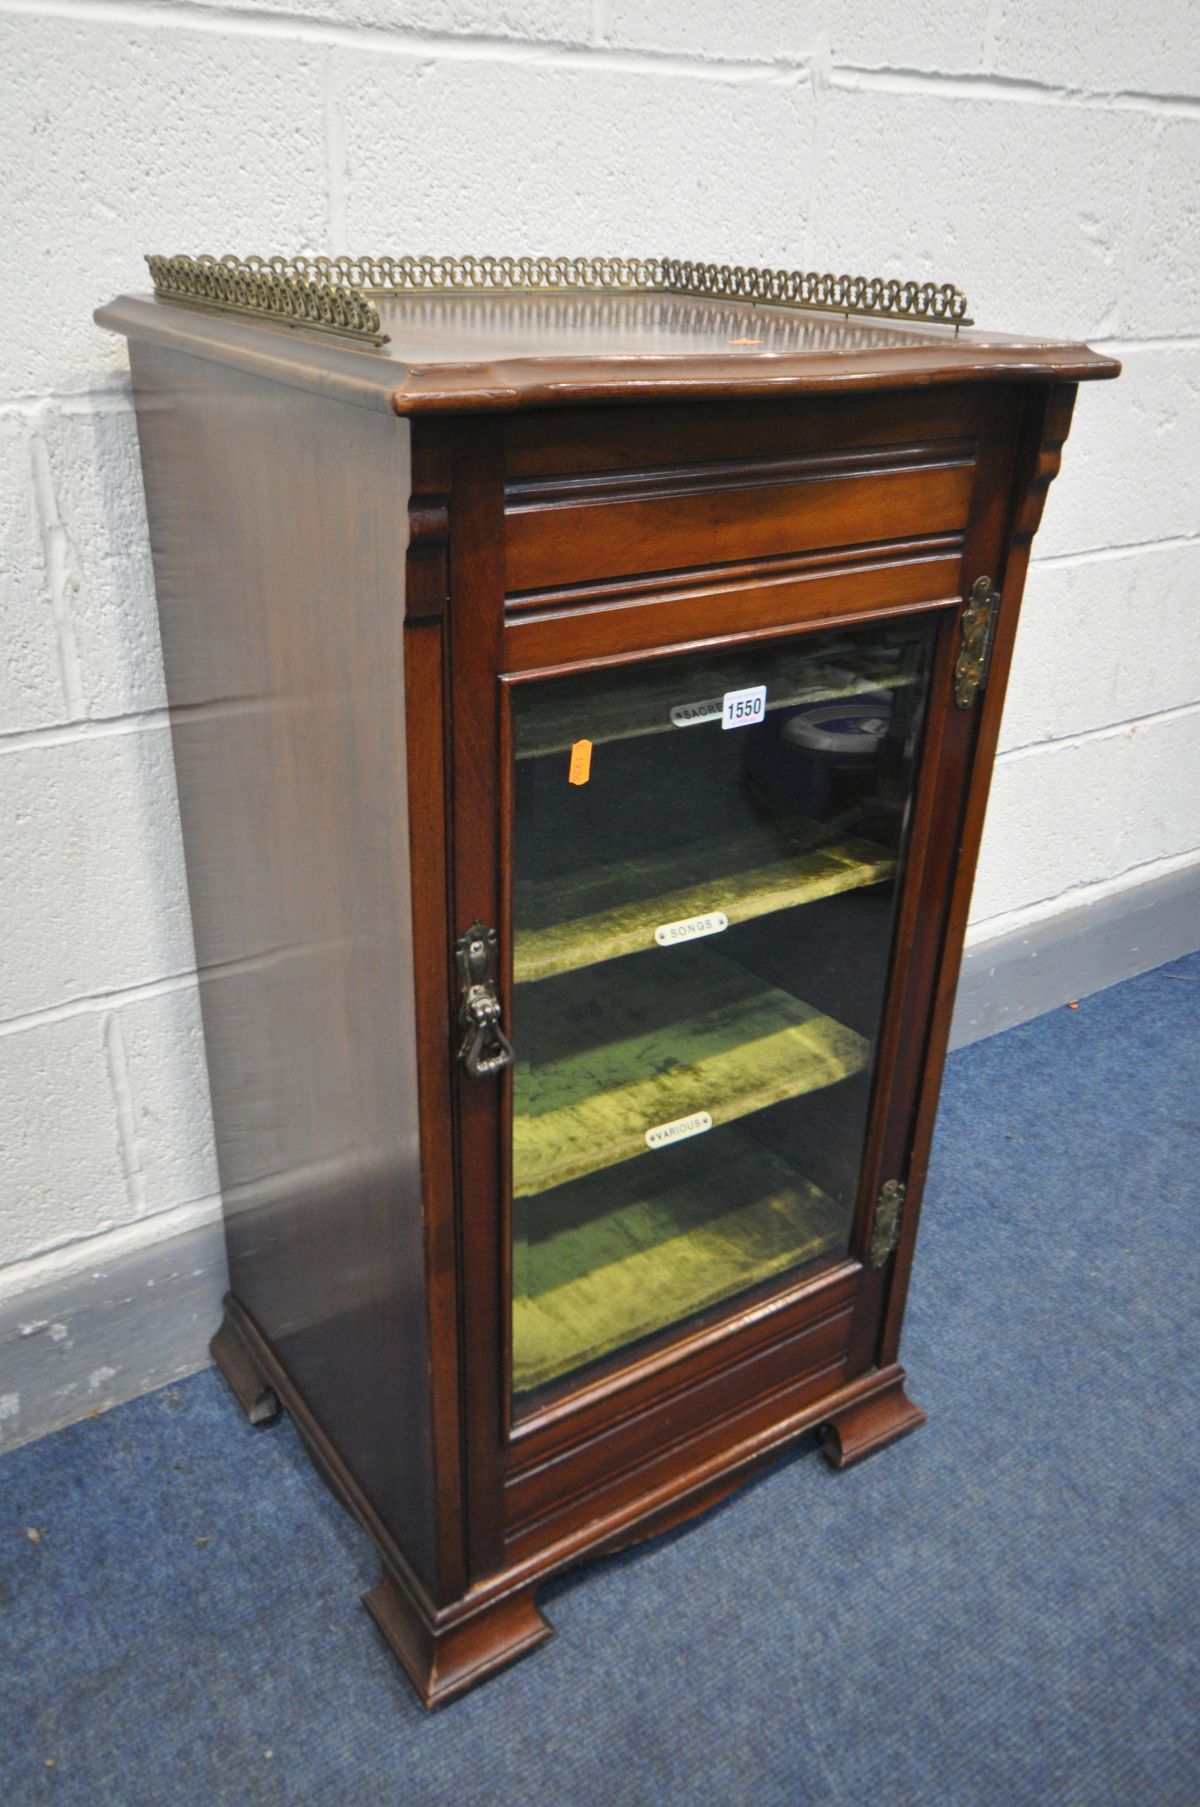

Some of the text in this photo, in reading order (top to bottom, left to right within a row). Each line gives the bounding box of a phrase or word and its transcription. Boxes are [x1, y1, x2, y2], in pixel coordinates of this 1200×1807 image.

[683, 702, 723, 720] SACRE
[728, 698, 761, 719] 1550
[670, 919, 712, 938] SONGS
[655, 1118, 701, 1140] VARIOUS
